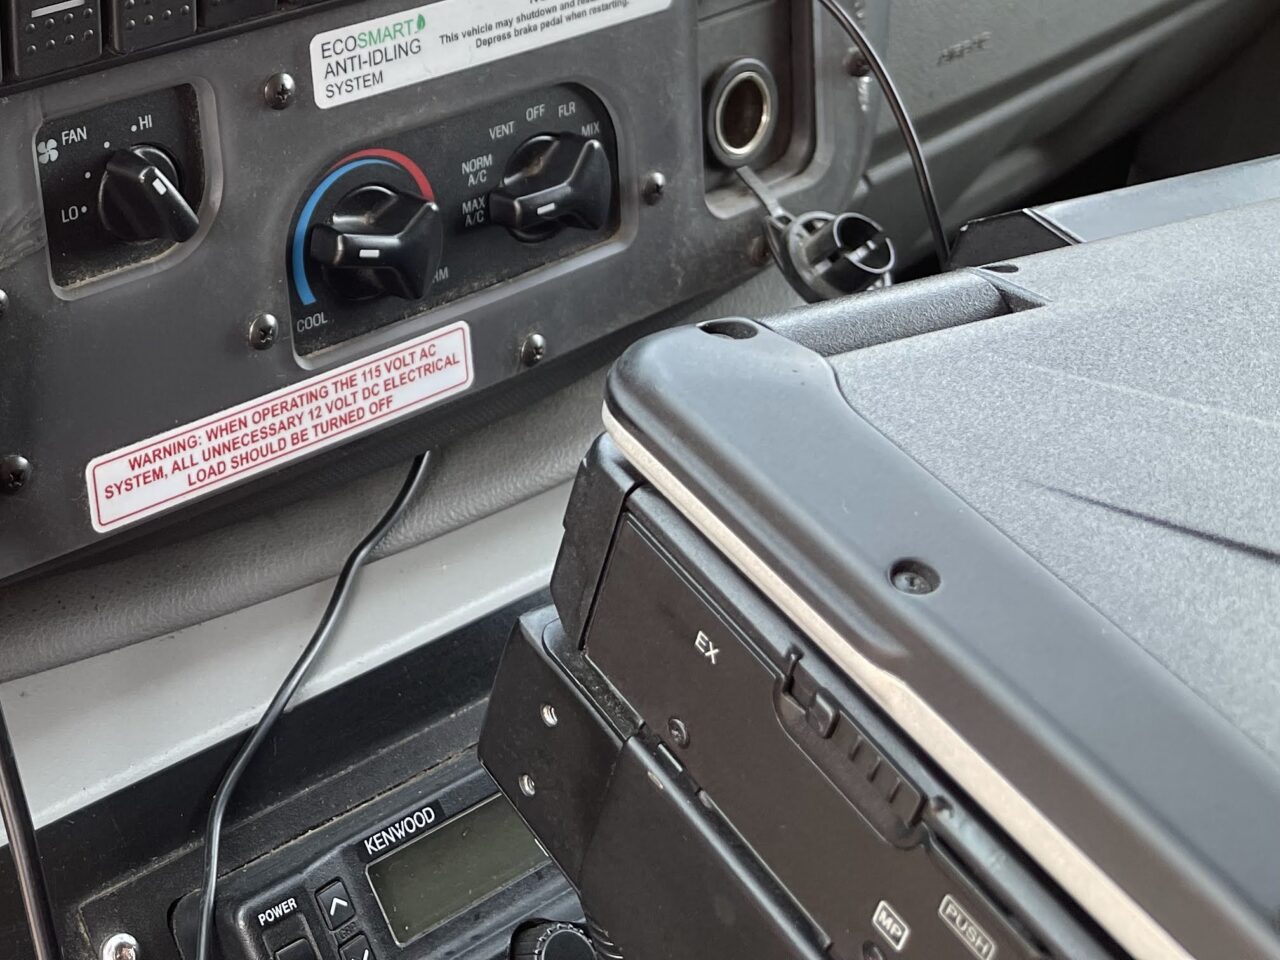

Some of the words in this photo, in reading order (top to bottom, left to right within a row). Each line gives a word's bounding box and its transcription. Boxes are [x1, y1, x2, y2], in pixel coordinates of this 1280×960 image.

[439, 32, 459, 45] This
[461, 23, 493, 39] vehicle
[495, 16, 513, 30] may
[516, 4, 557, 24] shutdown
[475, 31, 512, 49] Depress
[513, 23, 538, 38] brake
[540, 16, 563, 32] pedal
[565, 10, 587, 22] when
[321, 21, 417, 59] ECOSMART
[323, 38, 421, 79] ANTI-IDLING
[325, 70, 384, 99] SYSTEM
[138, 114, 153, 130] HI
[525, 104, 545, 122] OFF
[558, 101, 576, 118] FLR
[61, 126, 88, 146] FAN
[489, 121, 515, 140] VENT
[581, 121, 600, 137] MIX
[461, 153, 493, 175] NORM
[468, 170, 487, 187] A/C
[61, 205, 79, 223] LO
[462, 196, 486, 215] MAX
[465, 210, 485, 227] A/C
[296, 313, 328, 333] COOL
[128, 434, 202, 471] WARNING:
[205, 418, 248, 442] WHEN
[252, 387, 329, 424] OPERATING
[332, 374, 358, 394] THE
[361, 367, 382, 383] 115
[384, 351, 416, 373] VOLT
[420, 344, 437, 362] AC
[105, 465, 169, 499] SYSTEM,
[171, 457, 199, 474] ALL
[202, 412, 304, 462] UNNECESSARY
[308, 405, 322, 421] 12
[325, 392, 358, 413] VOLT
[362, 383, 380, 401] DC
[383, 353, 460, 391] ELECTRICAL
[187, 460, 226, 486] LOAD
[231, 437, 287, 470] SHOULD
[291, 428, 309, 446] BE
[312, 406, 365, 437] TURNED
[369, 395, 394, 415] OFF
[695, 630, 720, 665] EX
[363, 806, 436, 855] KENWOOD
[257, 897, 298, 927] POWER
[879, 909, 902, 937] MP
[945, 903, 989, 955] PUSH
